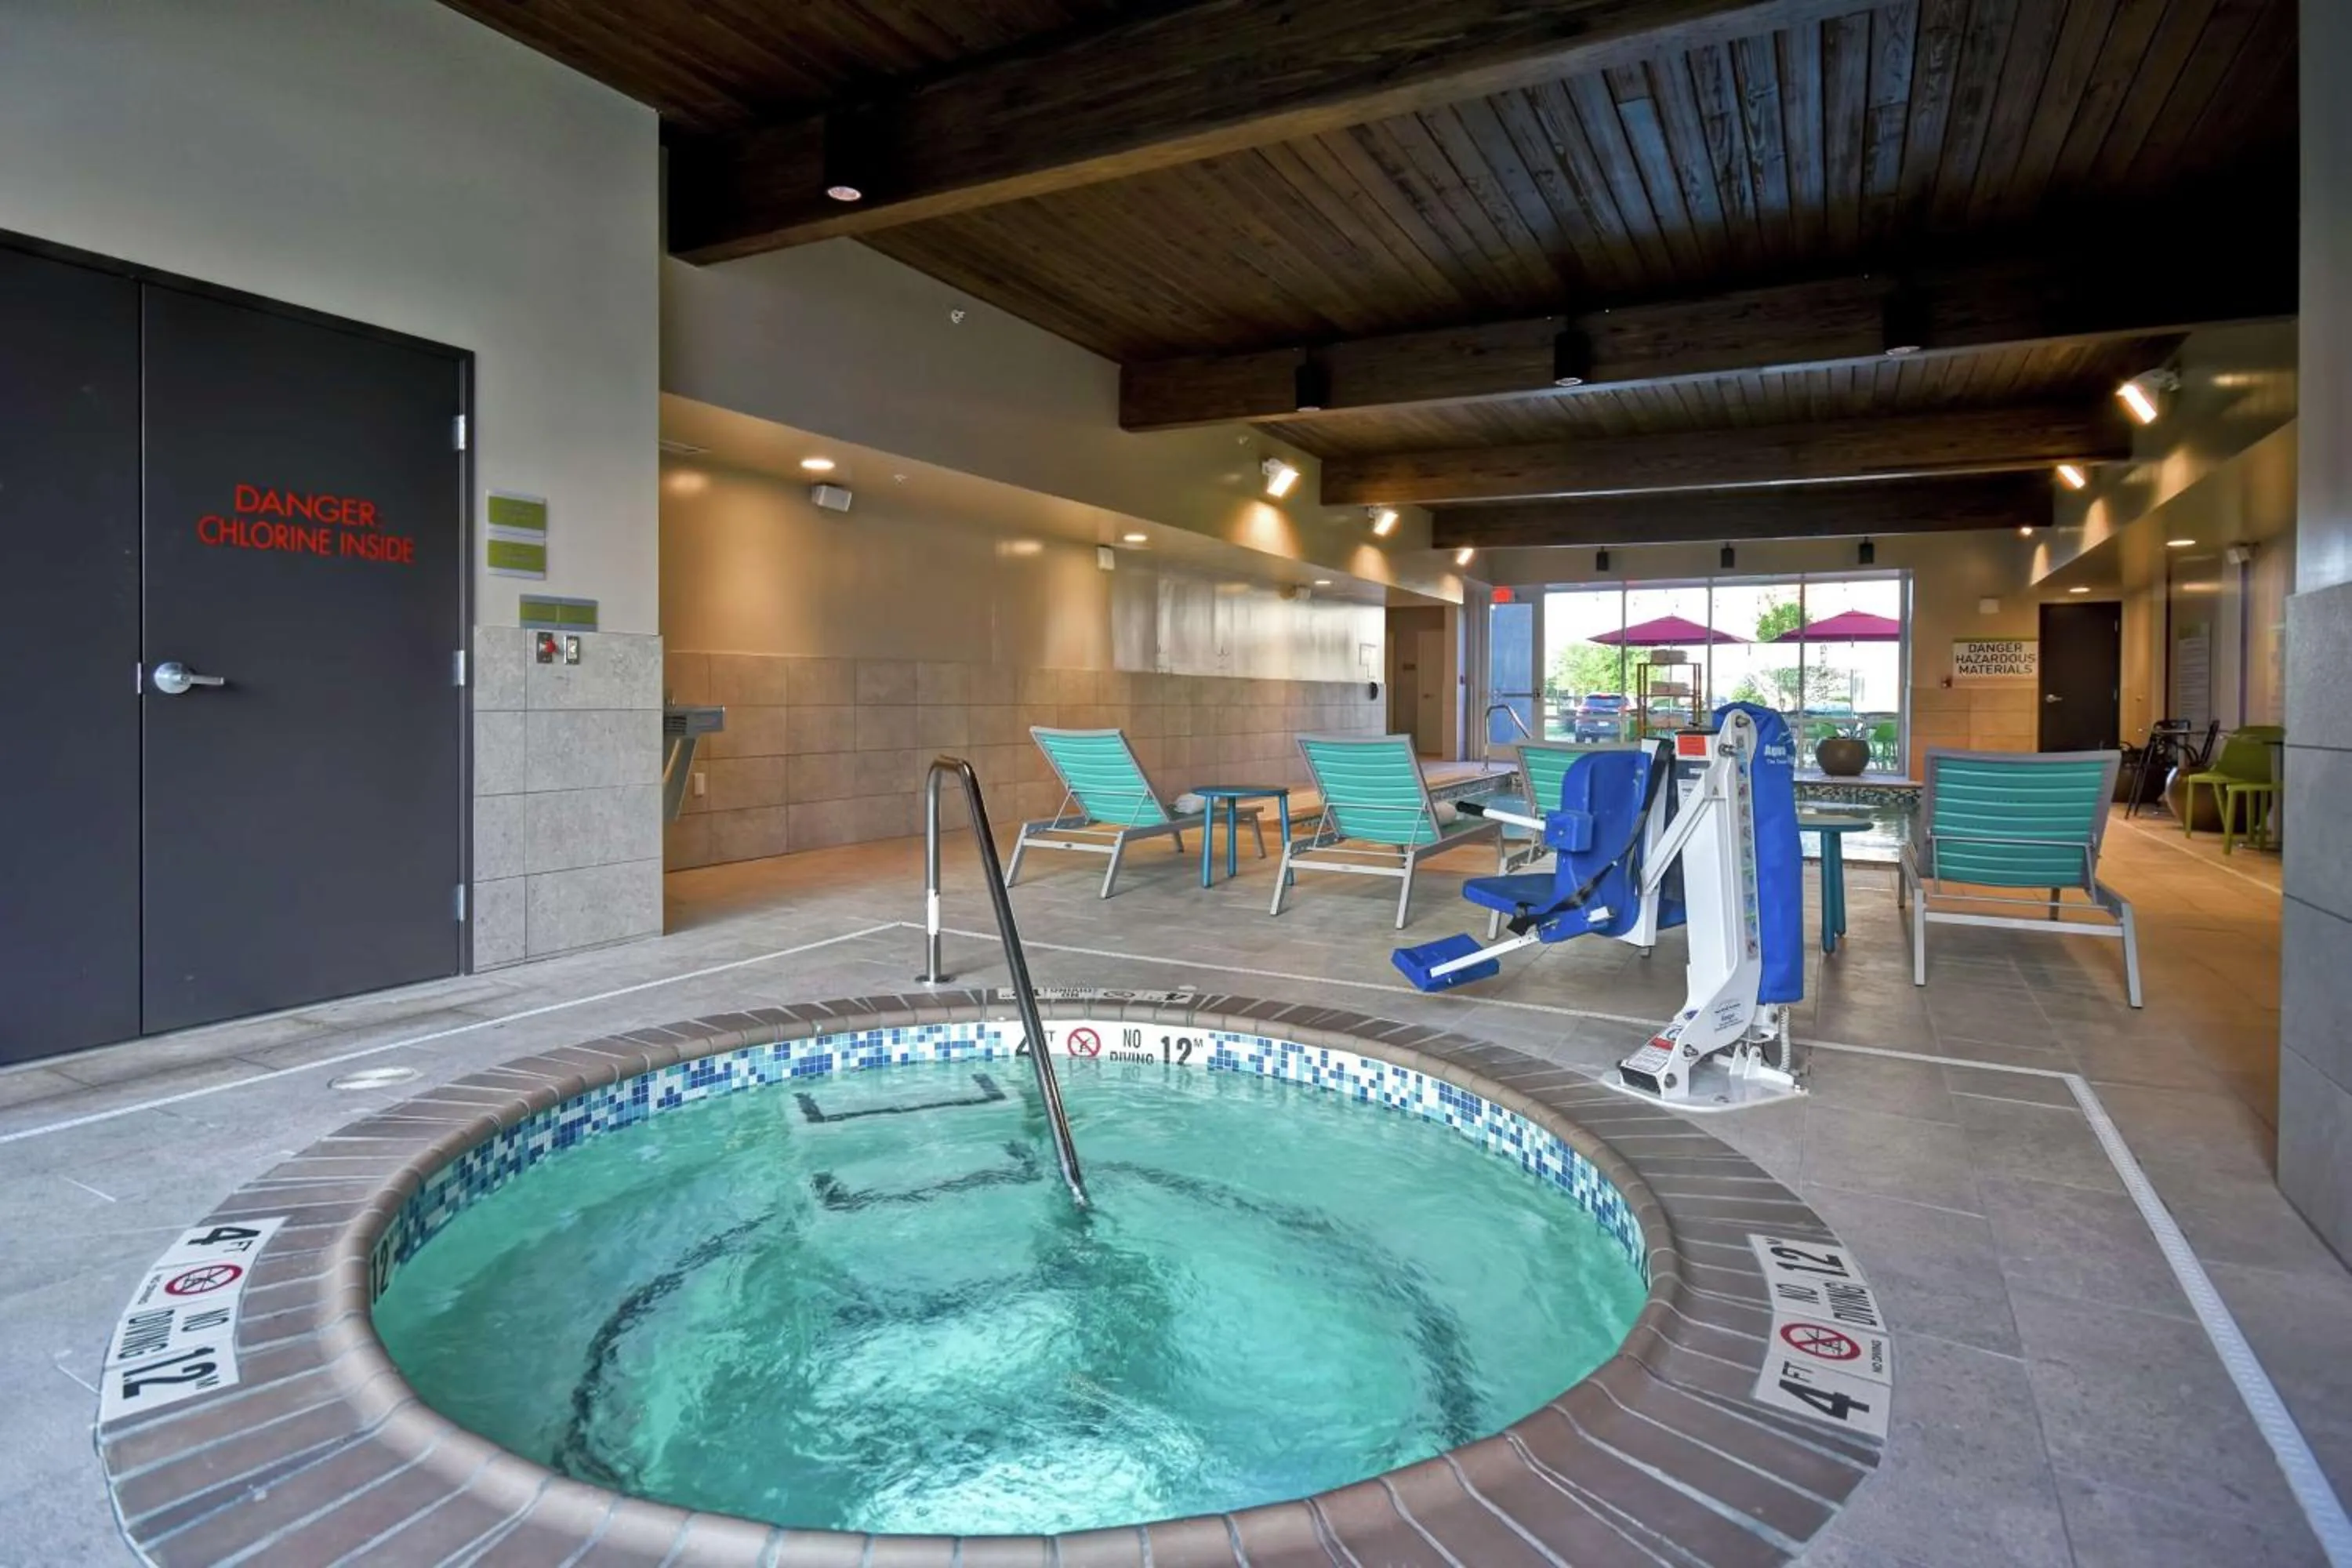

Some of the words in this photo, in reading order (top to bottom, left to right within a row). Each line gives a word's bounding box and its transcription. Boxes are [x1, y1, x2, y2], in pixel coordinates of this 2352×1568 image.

[198, 515, 332, 556] CHLORINE
[339, 532, 415, 564] INSIDE
[1955, 653, 2036, 664] HAZARDOUS
[1968, 643, 2023, 653] DANGER
[1958, 664, 2033, 675] MATERIALS
[1123, 1028, 1142, 1048] NO
[187, 1226, 261, 1246] 4
[223, 1240, 253, 1253] FT
[1776, 1283, 1820, 1305] NO
[1824, 1282, 1878, 1327] DIVING
[181, 1307, 230, 1332] NO
[118, 1308, 175, 1360] DIVING
[1782, 1360, 1814, 1383] FT
[1779, 1379, 1870, 1421] 4
